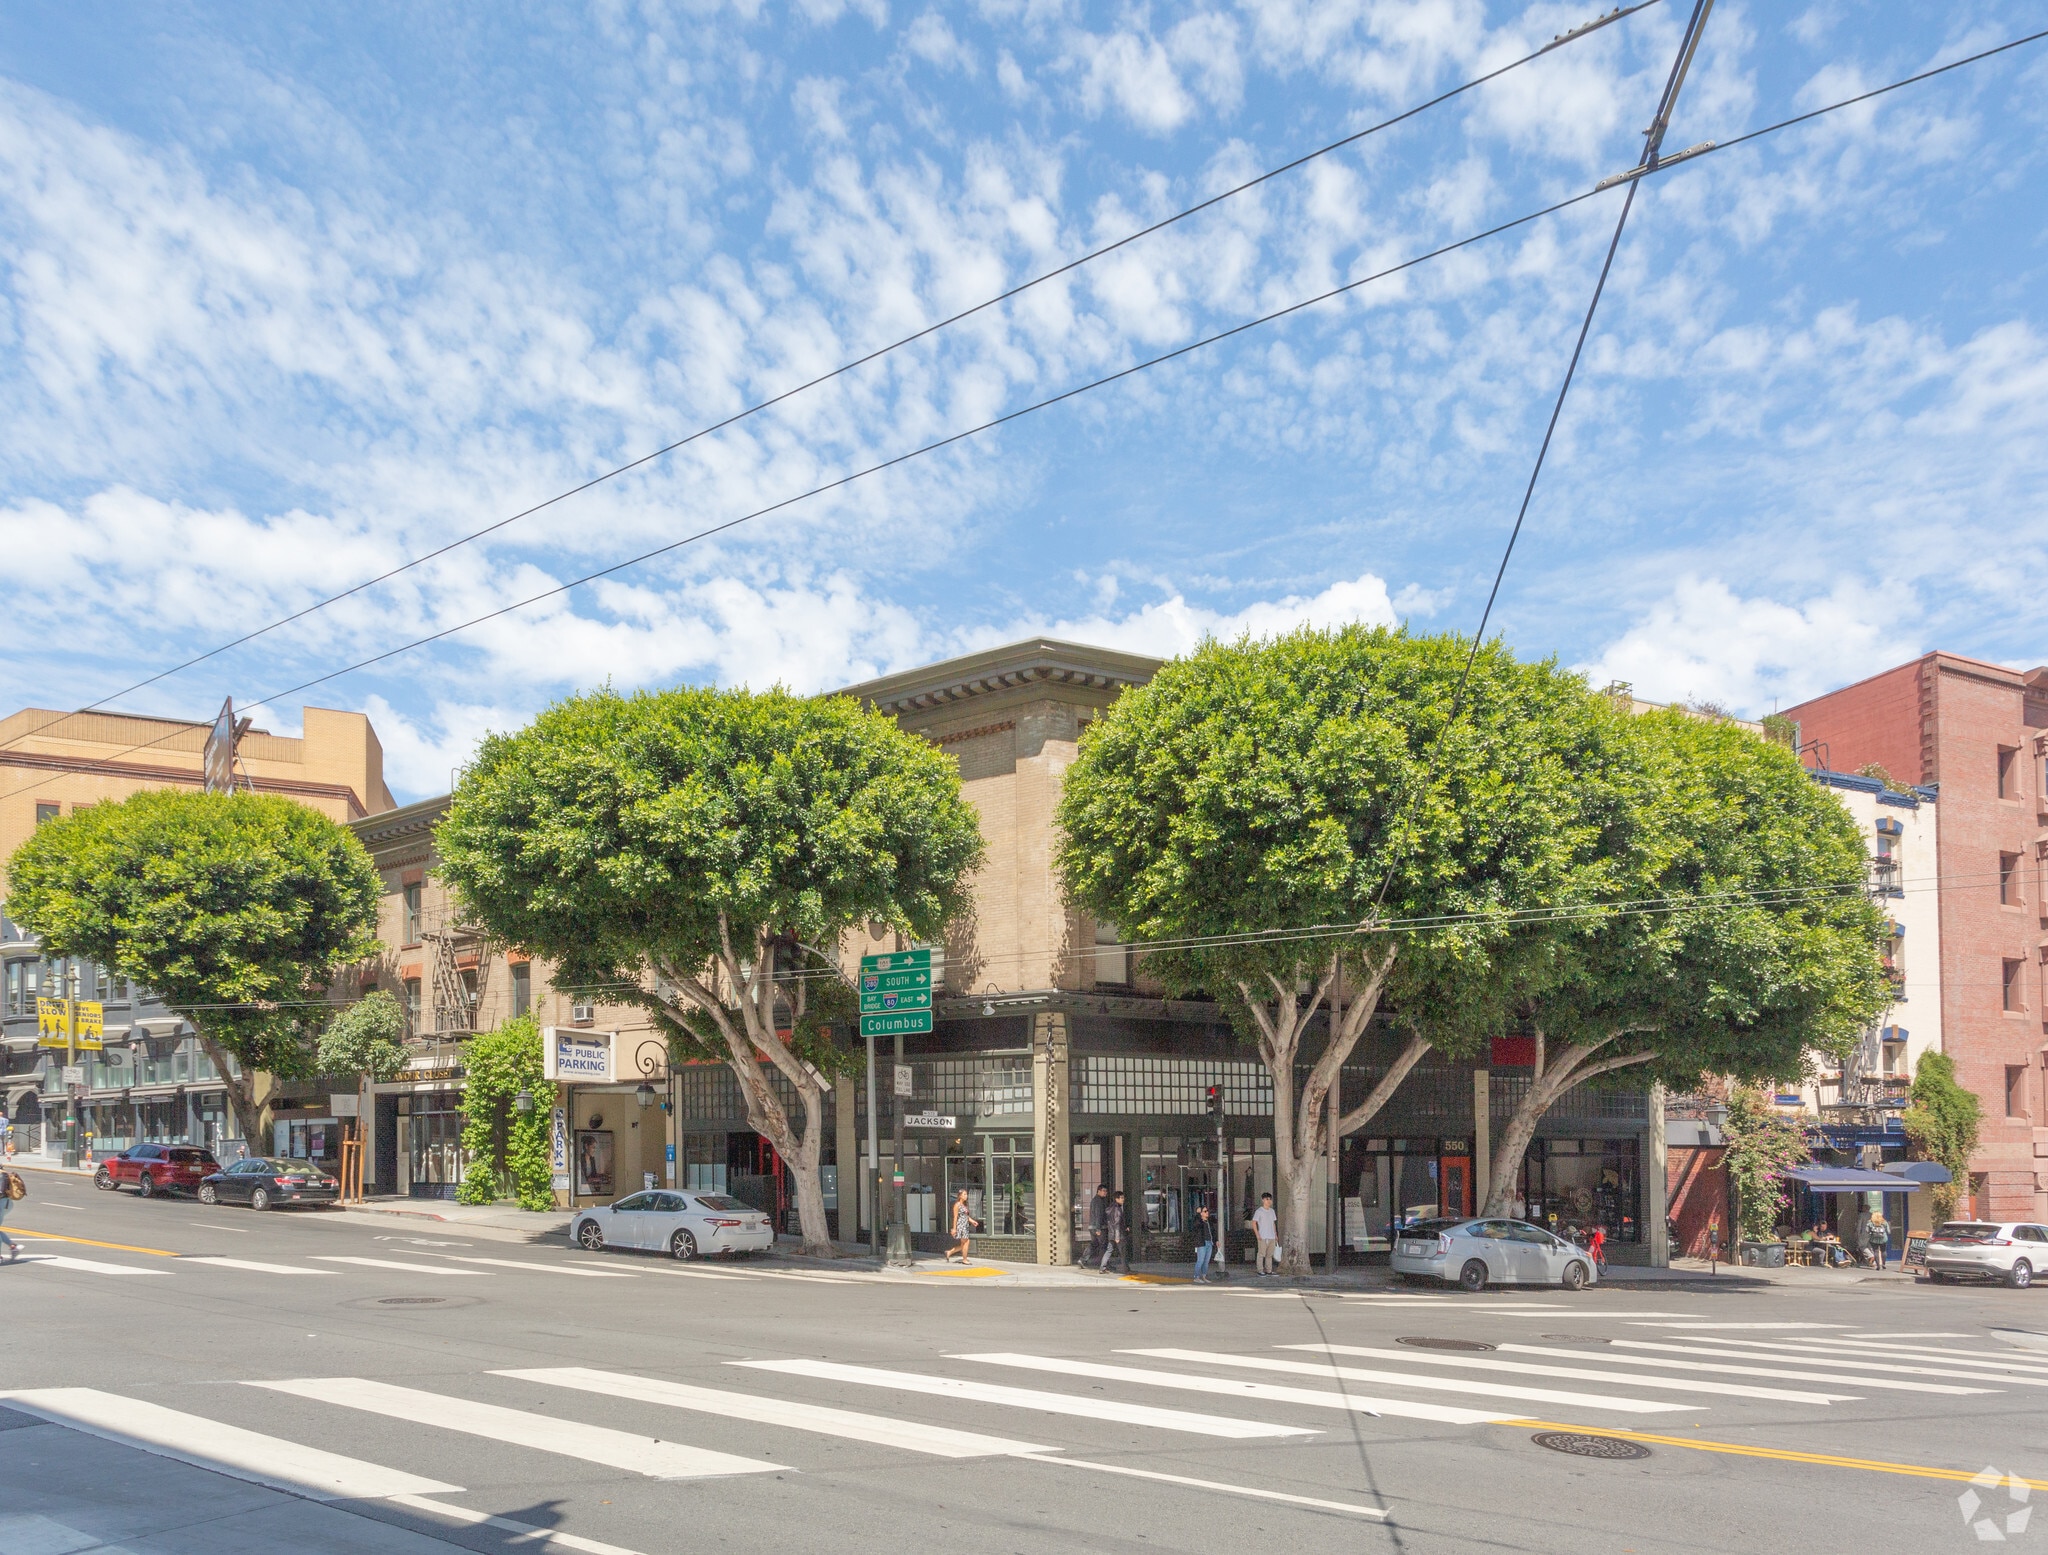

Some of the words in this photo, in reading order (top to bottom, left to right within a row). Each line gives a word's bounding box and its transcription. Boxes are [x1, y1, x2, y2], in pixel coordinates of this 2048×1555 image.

[886, 976, 910, 987] SOUTH
[40, 1008, 66, 1016] SLOW
[868, 1017, 923, 1031] Columbus
[576, 1049, 605, 1059] PUBLIC
[559, 1059, 605, 1071] PARKING
[907, 1117, 953, 1126] JACKSON
[1445, 1140, 1465, 1151] 550
